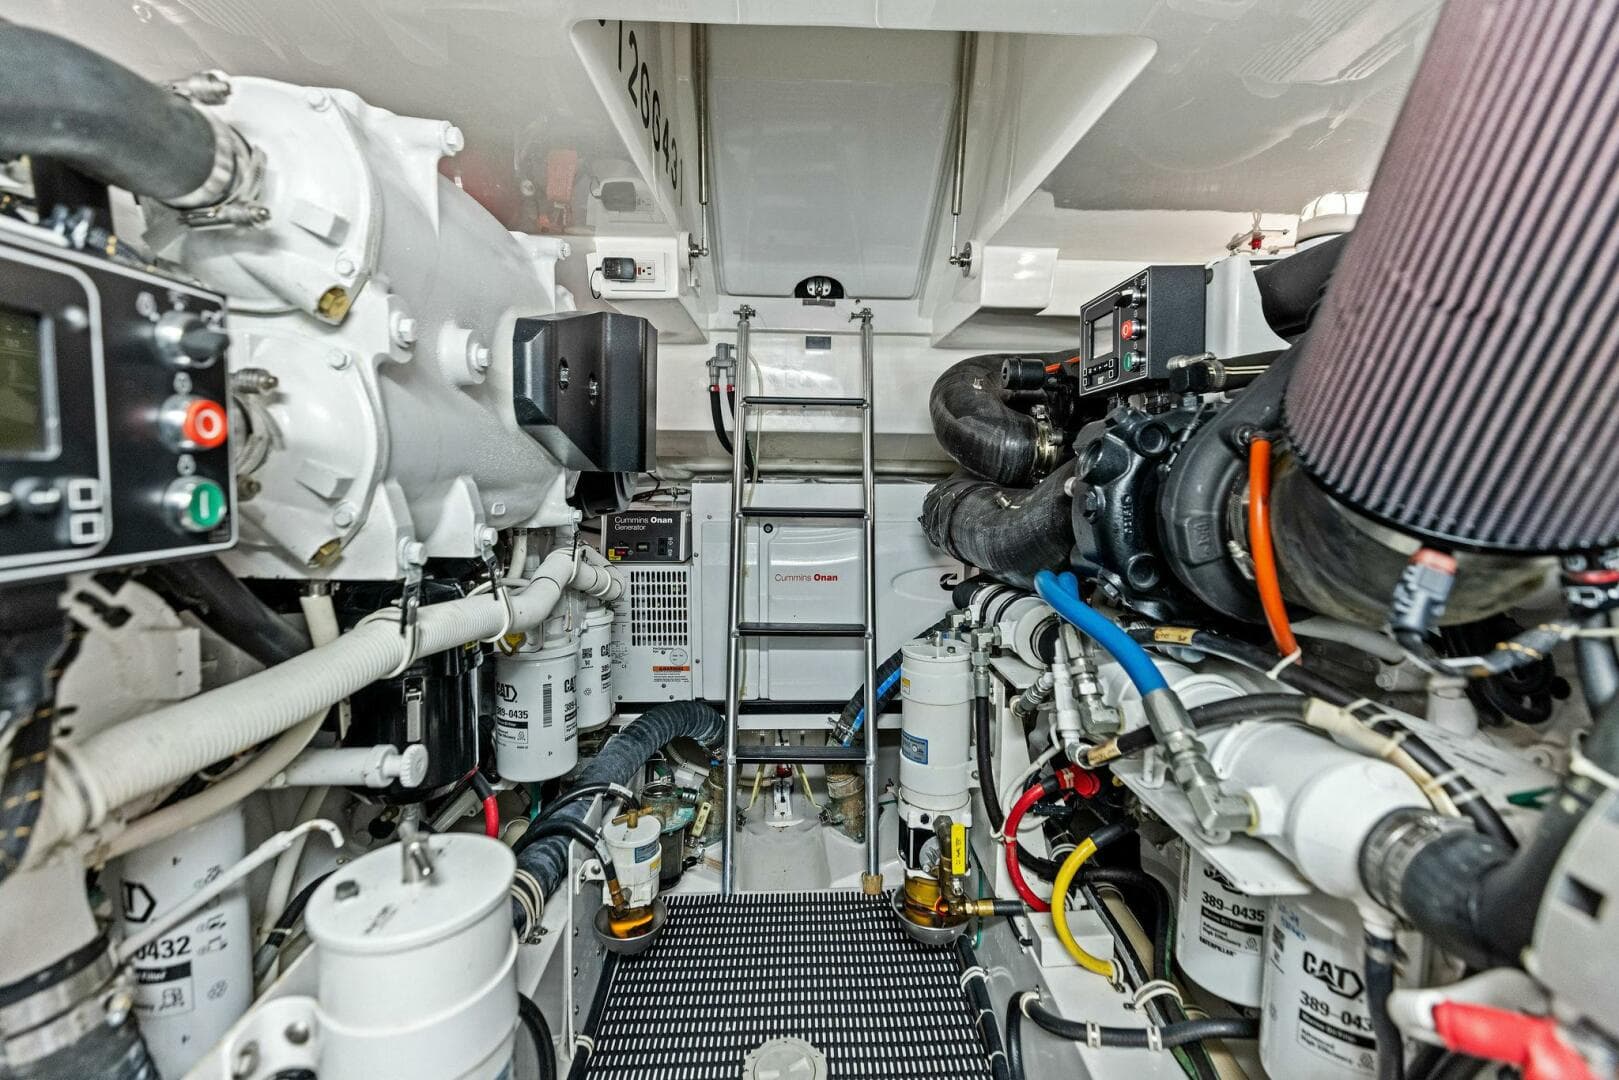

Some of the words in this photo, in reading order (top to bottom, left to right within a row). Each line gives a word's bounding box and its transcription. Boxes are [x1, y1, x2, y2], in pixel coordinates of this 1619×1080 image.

[614, 516, 649, 524] Cummins
[650, 516, 673, 524] Onan
[774, 573, 812, 582] Cummins
[813, 573, 838, 582] Onan
[1201, 890, 1266, 923] 389-0435
[1302, 950, 1354, 996] CAT
